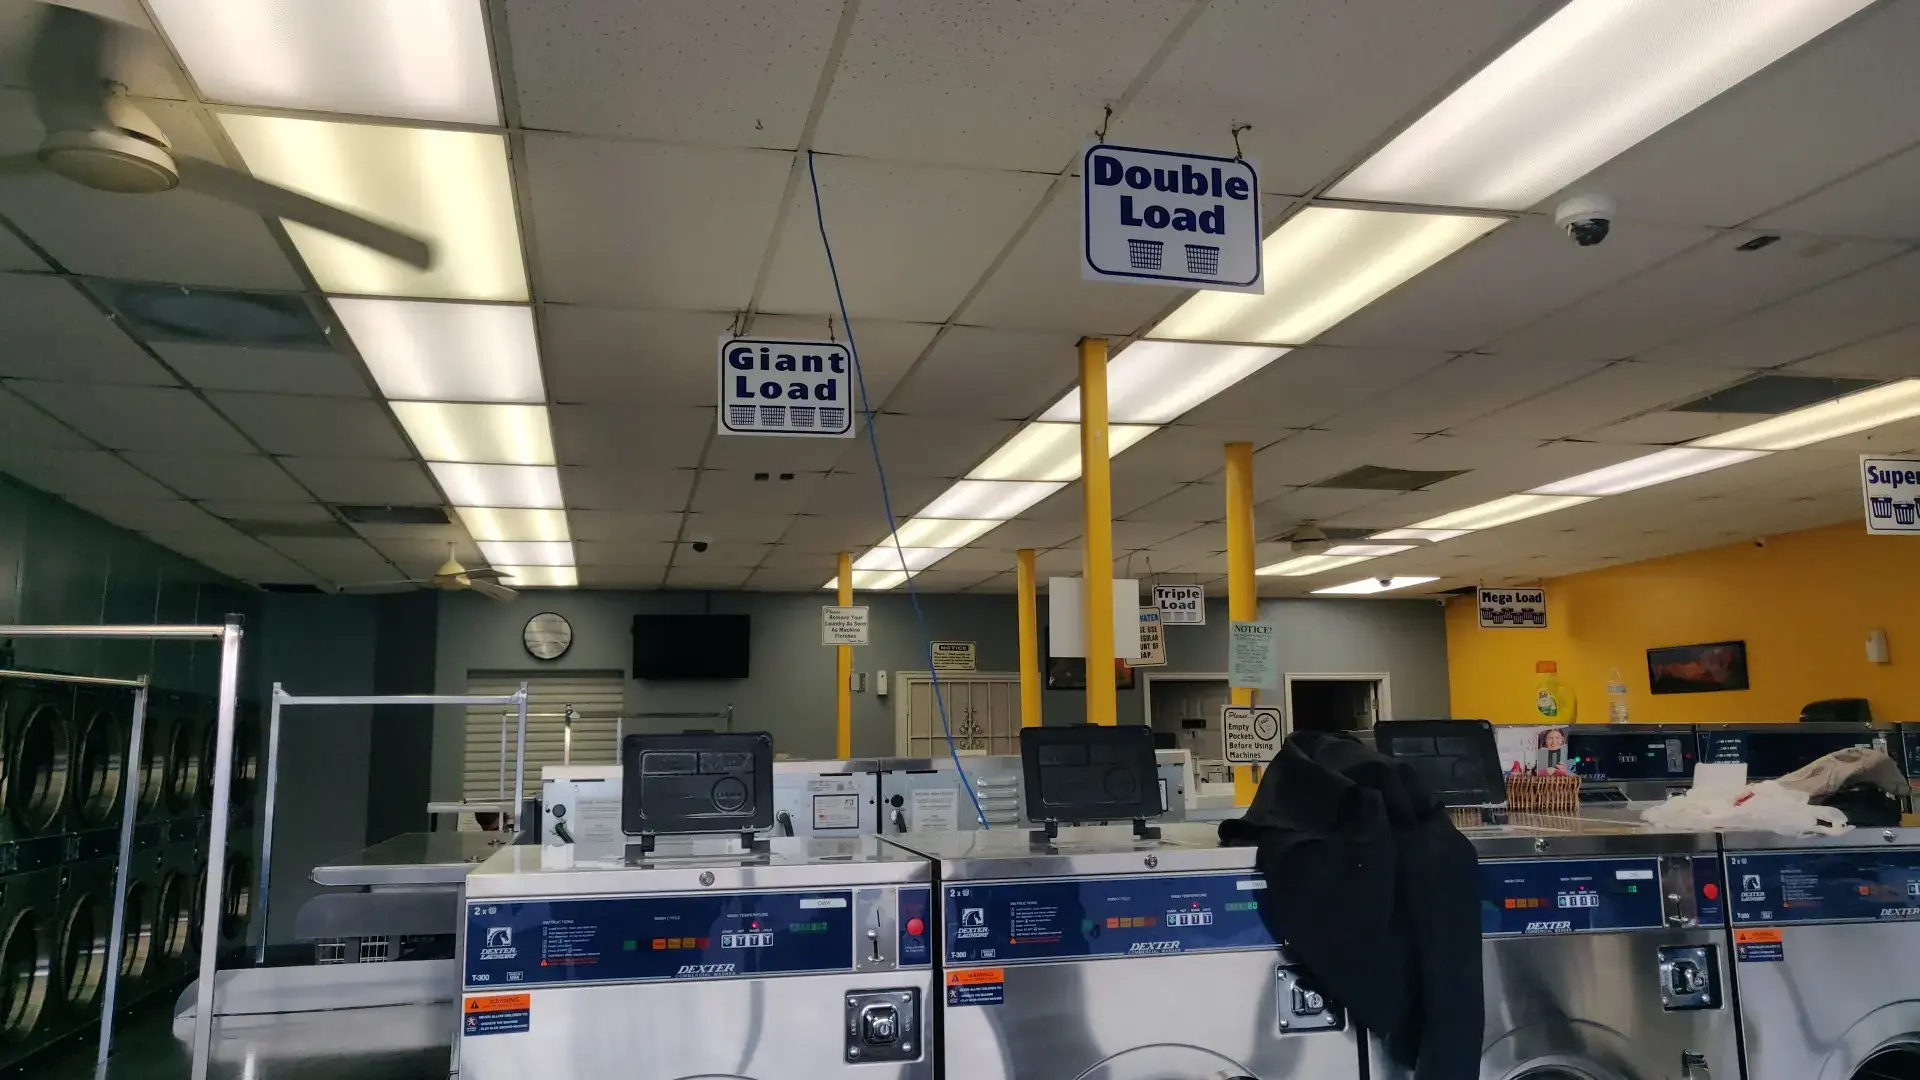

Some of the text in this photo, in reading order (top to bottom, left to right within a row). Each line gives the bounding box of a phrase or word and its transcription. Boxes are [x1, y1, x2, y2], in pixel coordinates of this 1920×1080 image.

[1093, 154, 1249, 200] Double
[1119, 194, 1225, 235] Load
[728, 347, 845, 374] Giant
[736, 375, 837, 401] Load
[1156, 588, 1200, 601] Triple
[1481, 591, 1542, 605] Mega Load
[1161, 600, 1196, 610] Load
[1147, 625, 1158, 633] USE
[1234, 624, 1273, 635] NOTICE!
[1228, 723, 1250, 731] Empty
[1228, 732, 1255, 740] Pockets
[1254, 742, 1273, 750] Using
[1229, 751, 1262, 759] Machines
[949, 889, 956, 898] 2
[474, 906, 481, 915] 2
[1881, 907, 1920, 916] DEXTER
[957, 926, 988, 934] DEXTER
[1526, 920, 1572, 930] DEXTER
[1129, 940, 1182, 951] DEXTER
[480, 947, 516, 955] DEXTER
[677, 963, 736, 974] DEXTER
